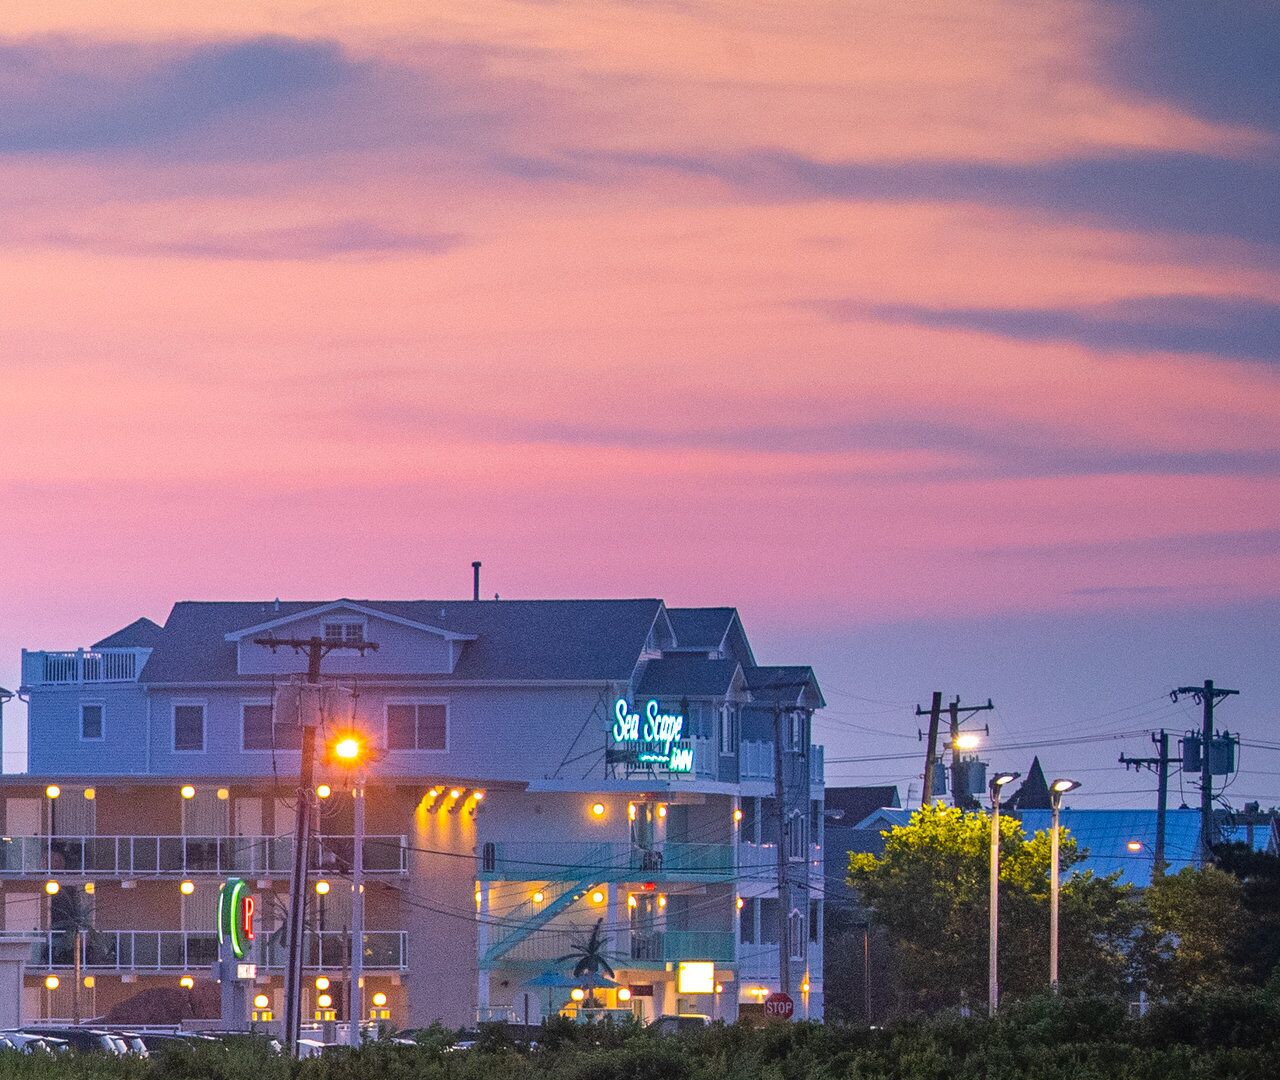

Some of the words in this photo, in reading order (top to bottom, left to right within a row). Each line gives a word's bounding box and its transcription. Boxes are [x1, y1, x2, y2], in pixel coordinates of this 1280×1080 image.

[613, 699, 640, 742] Sea
[643, 700, 683, 755] Scape
[766, 1001, 793, 1014] STOP
